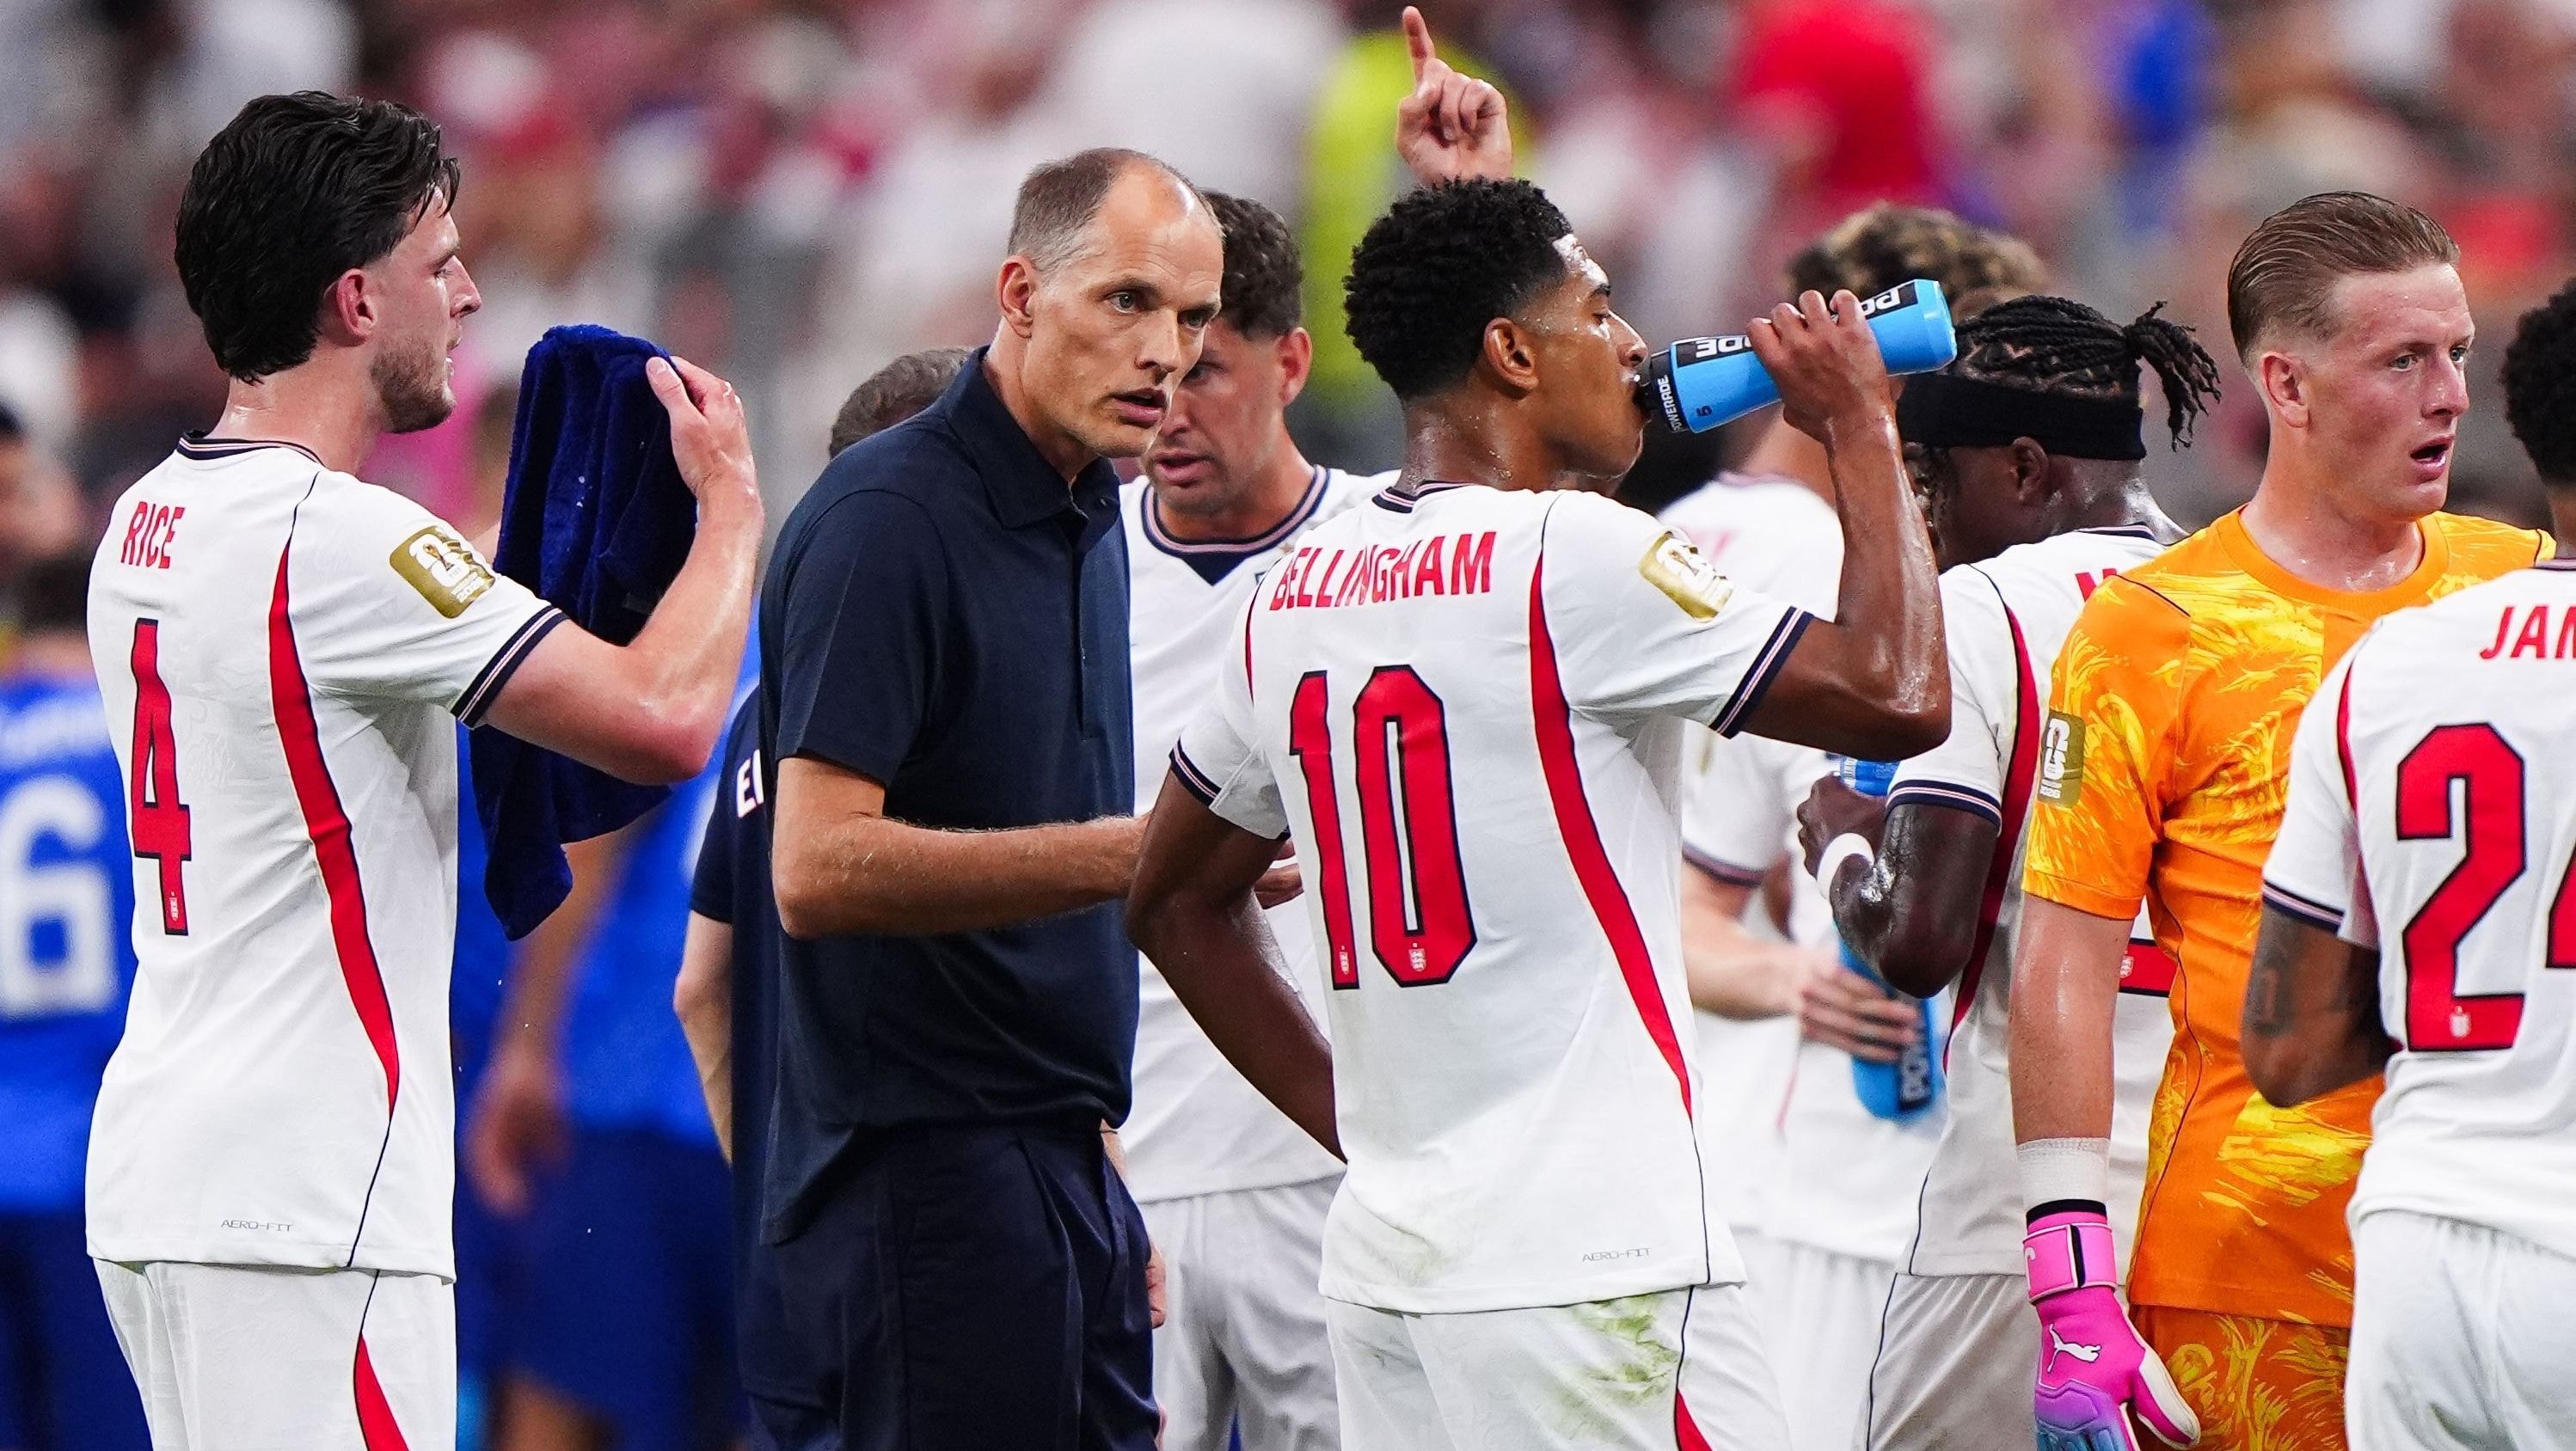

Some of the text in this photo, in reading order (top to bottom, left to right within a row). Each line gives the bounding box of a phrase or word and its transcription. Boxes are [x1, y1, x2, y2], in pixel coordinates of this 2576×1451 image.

[120, 501, 185, 569] RICE
[1269, 531, 1497, 610] BELLINGHAM
[131, 617, 192, 936] 4
[1289, 664, 1478, 989] 10
[0, 774, 117, 1014] 6
[2396, 721, 2576, 1052] 2
[219, 1218, 293, 1232] AERO-FIT
[1581, 1246, 1651, 1262] AERO-FIT
